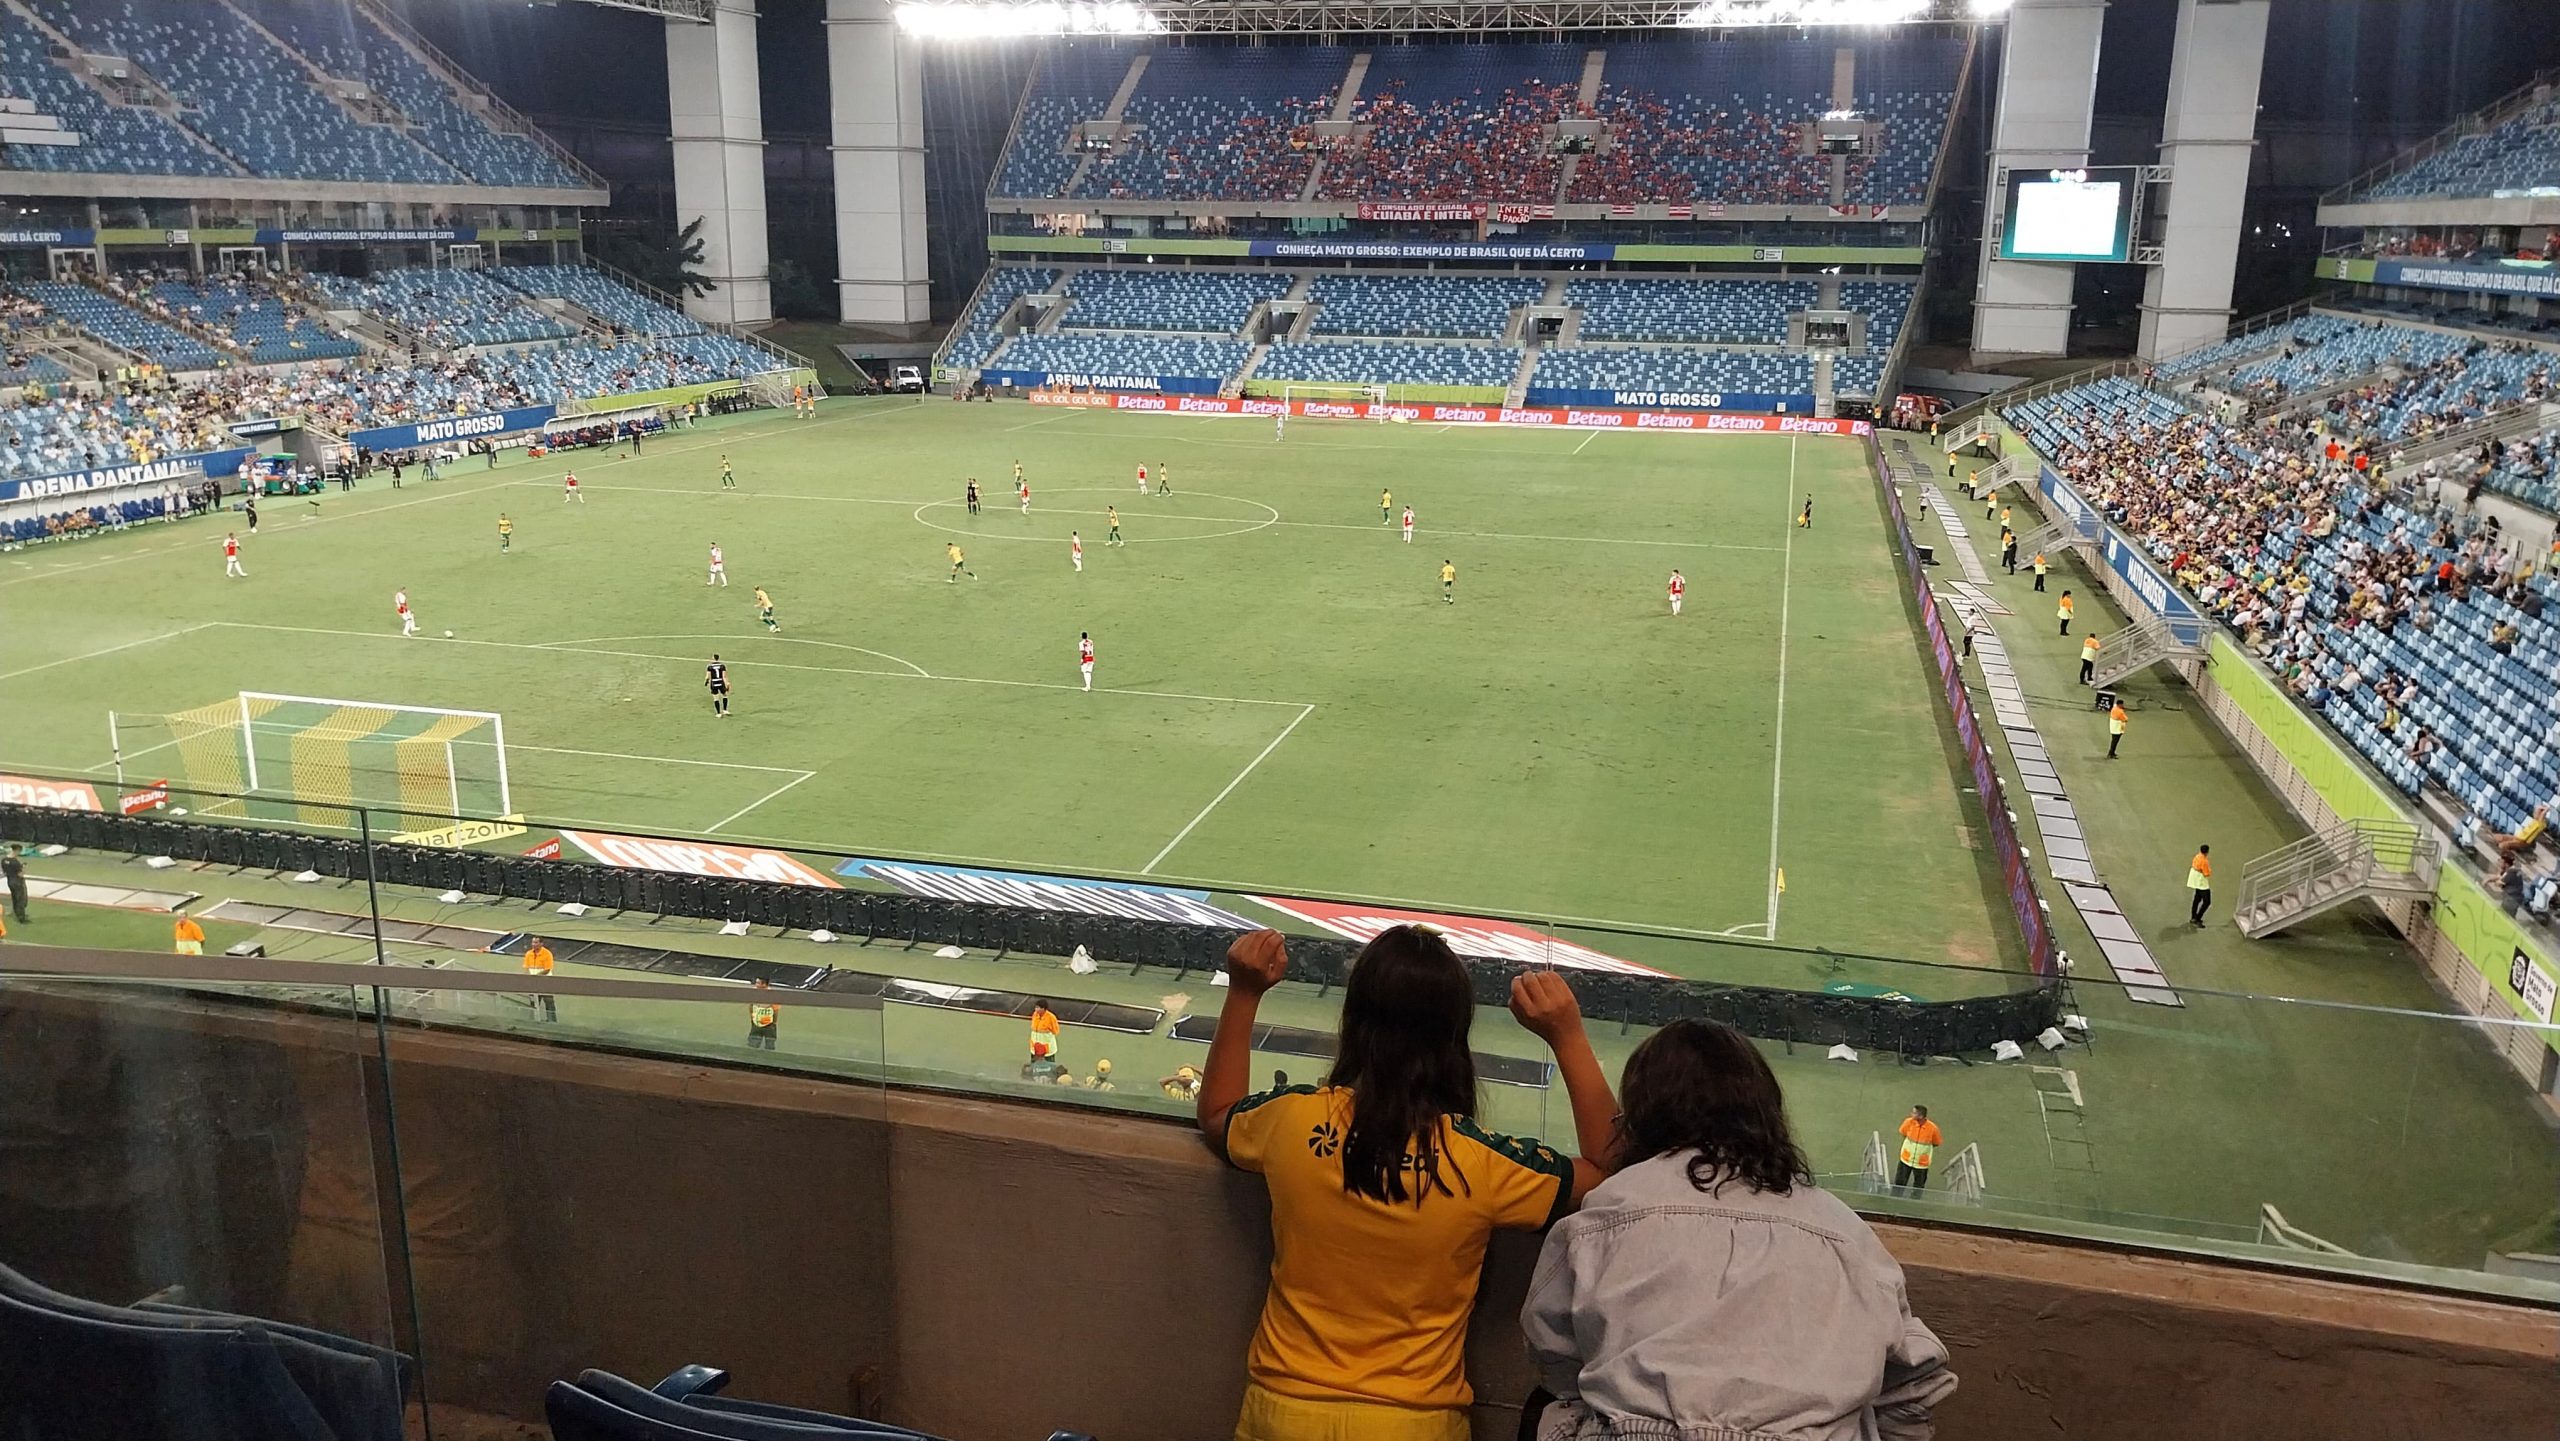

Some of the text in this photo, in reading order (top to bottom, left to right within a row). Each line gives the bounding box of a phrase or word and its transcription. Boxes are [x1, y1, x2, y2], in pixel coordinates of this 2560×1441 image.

[1434, 211, 1472, 220] INTER
[1498, 203, 1530, 214] INTER
[0, 230, 62, 243] QUE DÁ CERTO
[282, 231, 313, 242] CONHEÇA
[437, 231, 455, 239] CERTO
[1276, 244, 1585, 258] CONHEÇA MATO GROSSO: EXEMPLO DE BRASIL QUE DÁ CERTO
[2401, 267, 2424, 285] CONHEÇA
[2424, 269, 2440, 284] MATO
[2465, 271, 2492, 288] EXEMPLO
[2493, 273, 2503, 289] DE
[2503, 274, 2527, 291] BRASIL
[2527, 275, 2541, 293] QUE
[2542, 273, 2553, 293] DÁ
[1046, 373, 1161, 390] ARENA PANTANAL
[1033, 395, 1108, 406] GOL GOL GOL GOL
[1118, 395, 1166, 410] Betano
[1179, 398, 1228, 413] Betano
[1241, 399, 1291, 415] Betano
[1614, 391, 1721, 408] MATO GROSSO
[1434, 406, 1486, 422] Betano
[1500, 408, 1553, 424] Betano
[1568, 411, 1622, 426] Betano
[1637, 412, 1693, 428] Betano
[416, 414, 504, 443] MATO GROSSO
[1707, 414, 1764, 431] Betano
[1780, 416, 1838, 433] Betano
[18, 473, 88, 500] ARENA
[123, 784, 167, 809] Betano
[2528, 976, 2542, 998] Mato
[2526, 988, 2545, 1016] Grosso
